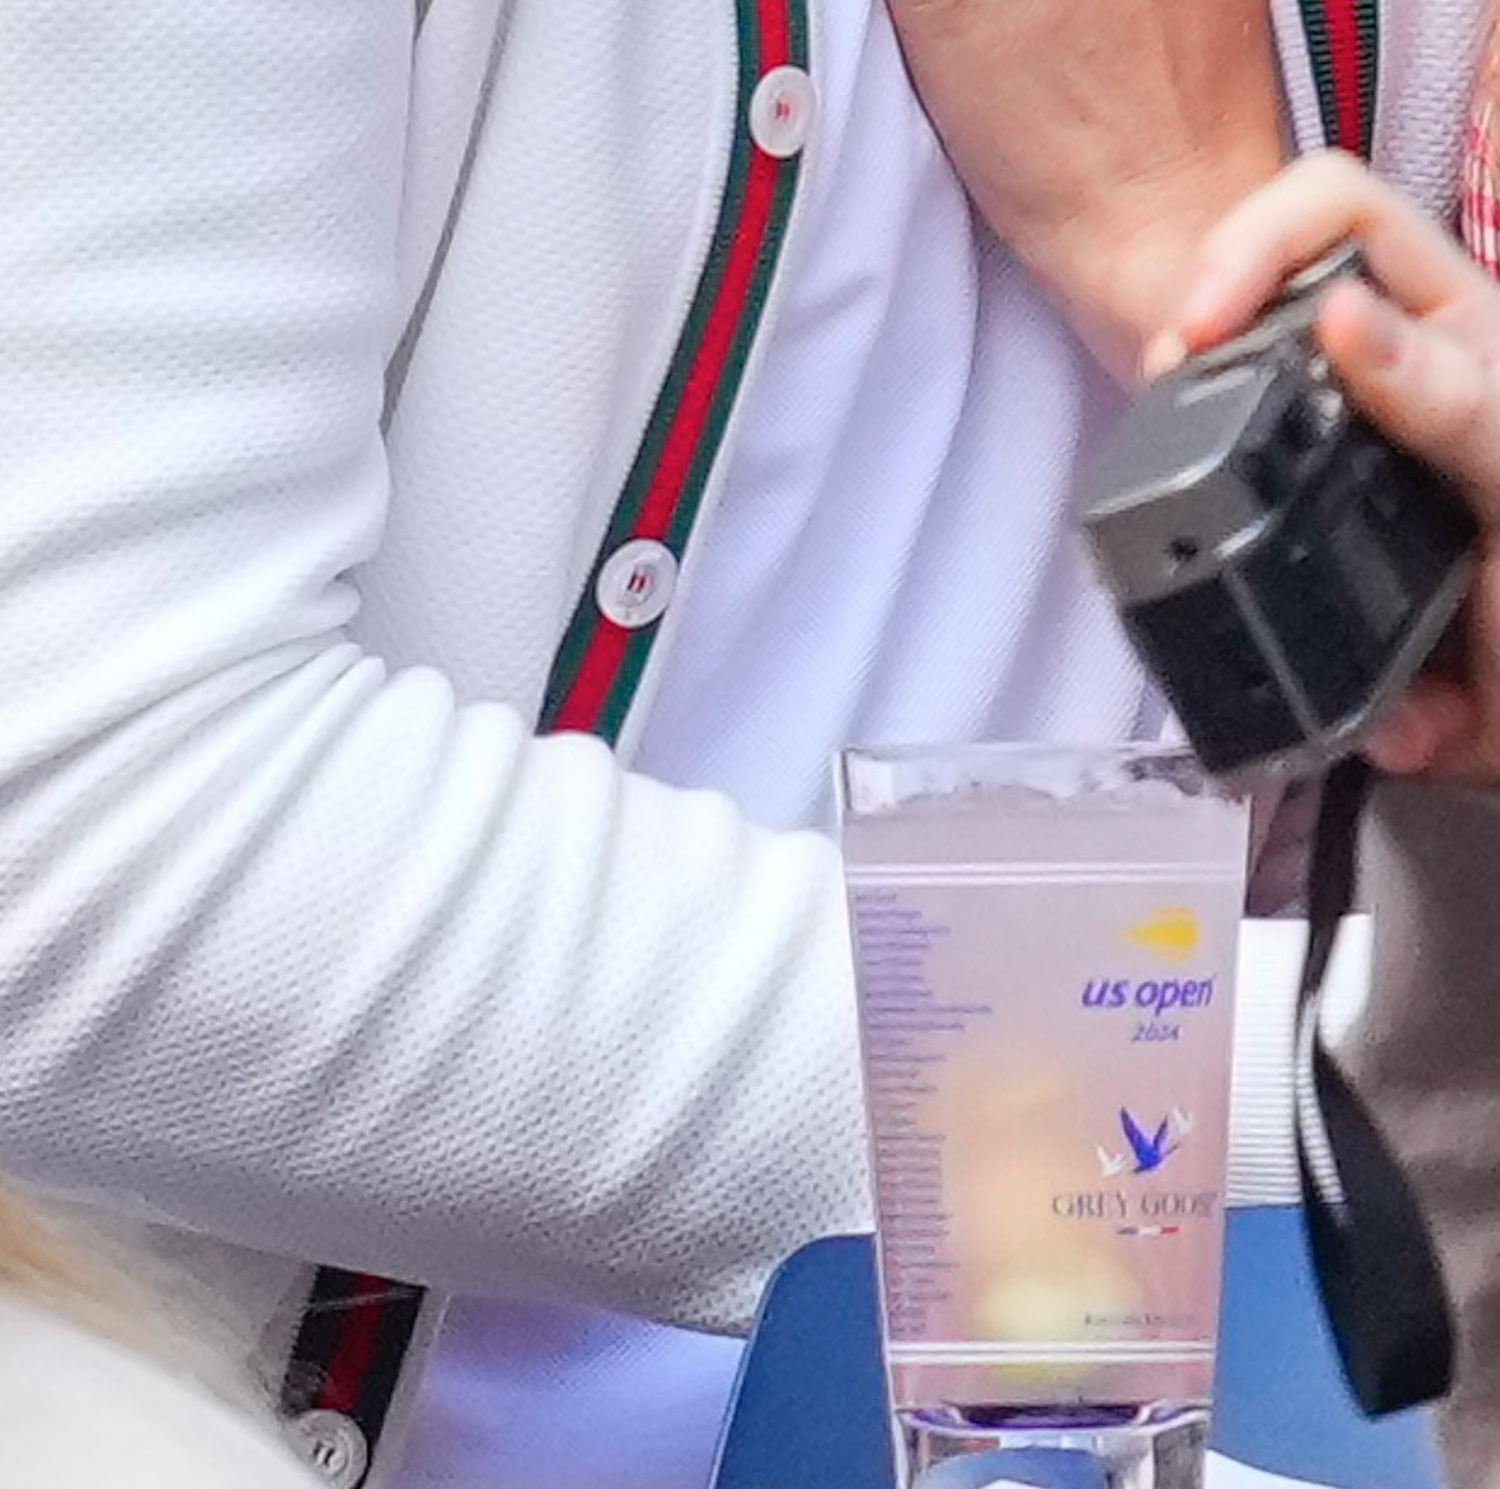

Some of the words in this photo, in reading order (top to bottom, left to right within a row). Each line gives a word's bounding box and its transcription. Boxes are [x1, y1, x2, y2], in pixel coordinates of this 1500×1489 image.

[1082, 978, 1128, 1008] us
[1135, 976, 1216, 1016] open
[1052, 1190, 1128, 1218] GREY
[1140, 1190, 1217, 1218] GOOS
